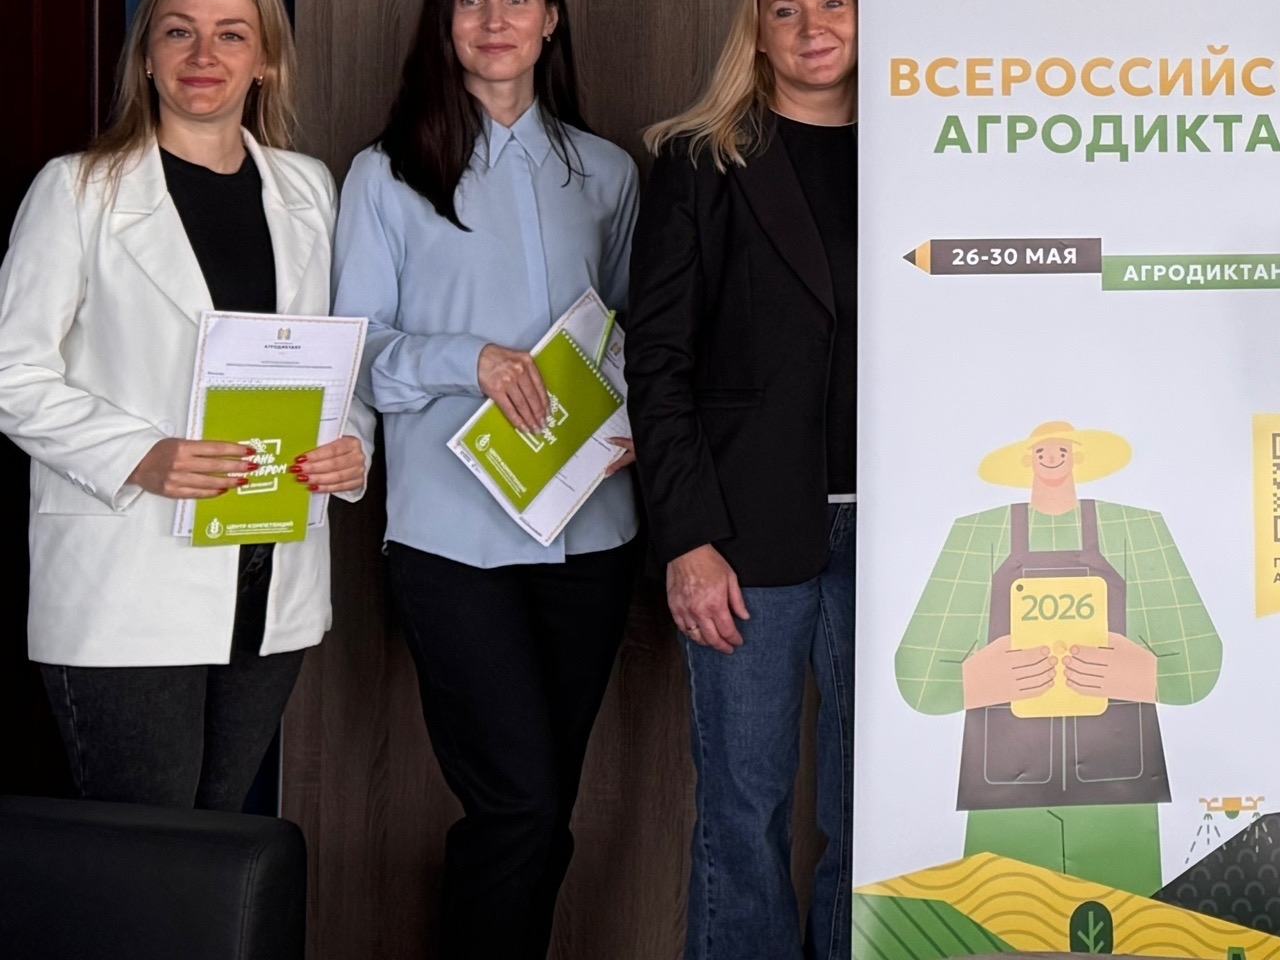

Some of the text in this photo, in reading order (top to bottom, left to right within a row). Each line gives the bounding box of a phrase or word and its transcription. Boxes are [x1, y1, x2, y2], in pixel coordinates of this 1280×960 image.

[951, 248, 1077, 266] 26-30 МАЯ
[1021, 593, 1095, 622] 2026
